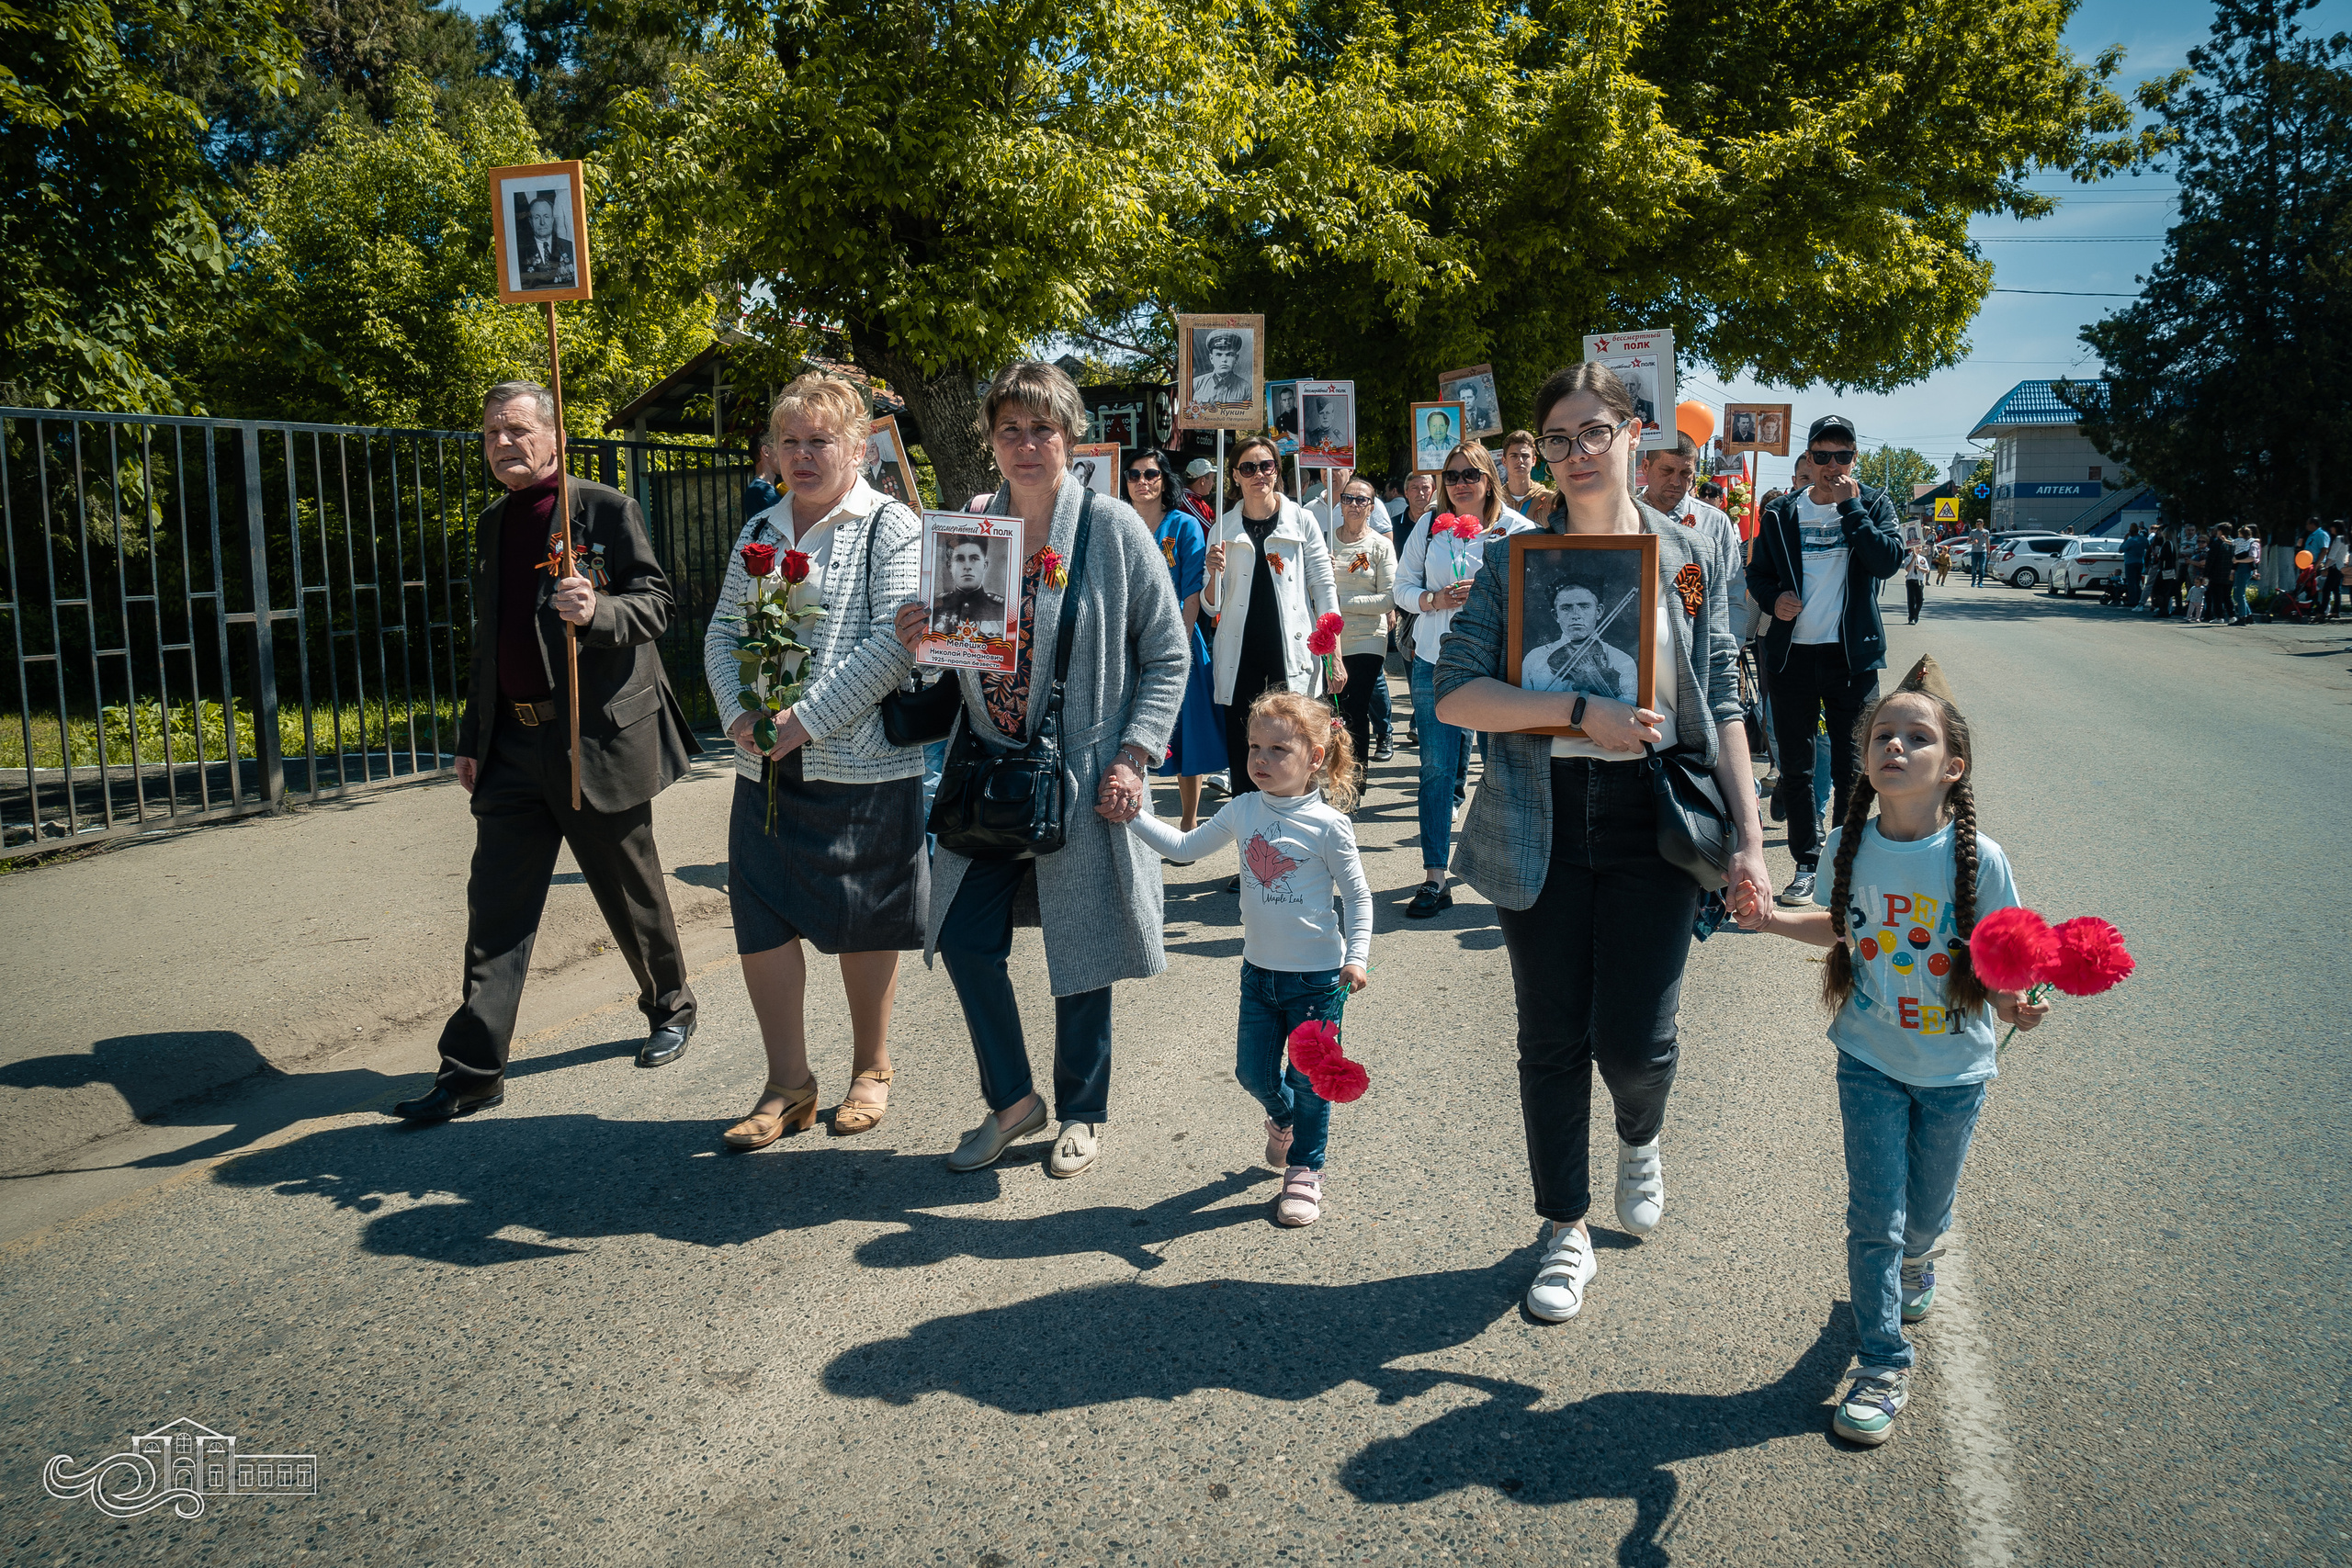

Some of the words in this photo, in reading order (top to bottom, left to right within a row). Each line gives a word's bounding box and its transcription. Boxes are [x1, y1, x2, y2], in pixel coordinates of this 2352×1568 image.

[1611, 332, 1662, 342] бессмертный
[1623, 341, 1651, 351] ПОЛК
[1220, 409, 1246, 417] Кукин
[2035, 486, 2080, 494] АПТЕКА
[931, 513, 979, 534] бессмертный
[993, 528, 1013, 536] ПОЛК
[946, 639, 988, 650] Мелешко
[930, 648, 961, 657] Николай
[963, 651, 1003, 661] Романович
[1264, 894, 1287, 905] Maple
[1289, 894, 1304, 905] Leaf
